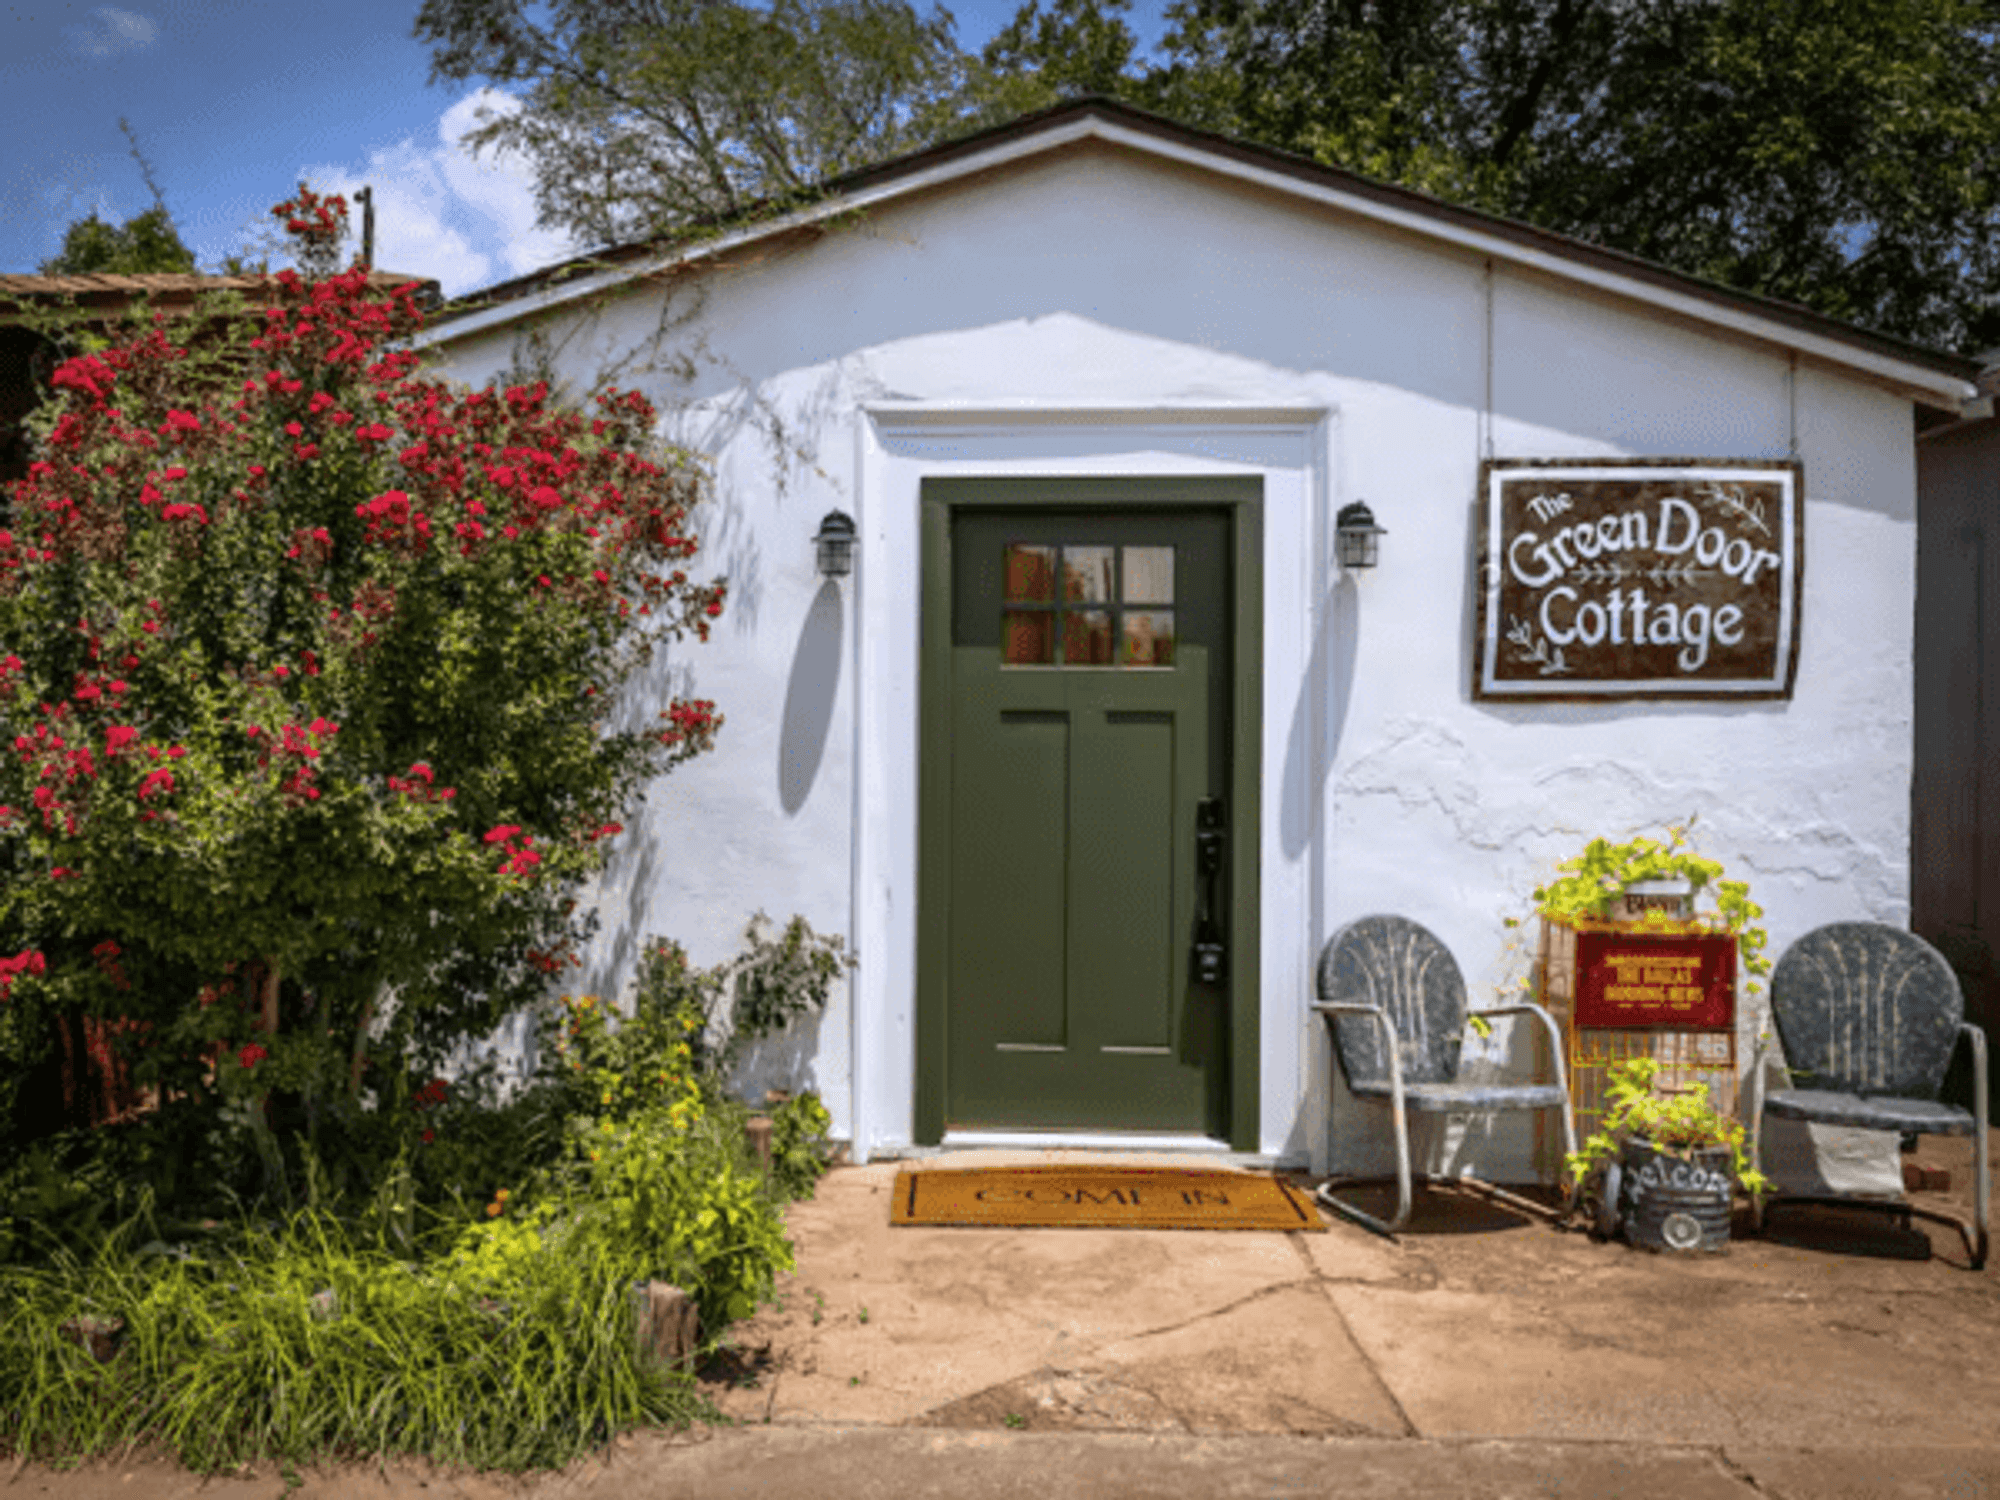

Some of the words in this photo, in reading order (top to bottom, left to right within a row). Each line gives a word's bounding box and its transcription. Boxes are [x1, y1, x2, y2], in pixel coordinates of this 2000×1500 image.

[1509, 510, 1650, 588] Green
[1654, 497, 1782, 585] Door
[1526, 492, 1574, 523] The
[1540, 585, 1745, 672] Cottage
